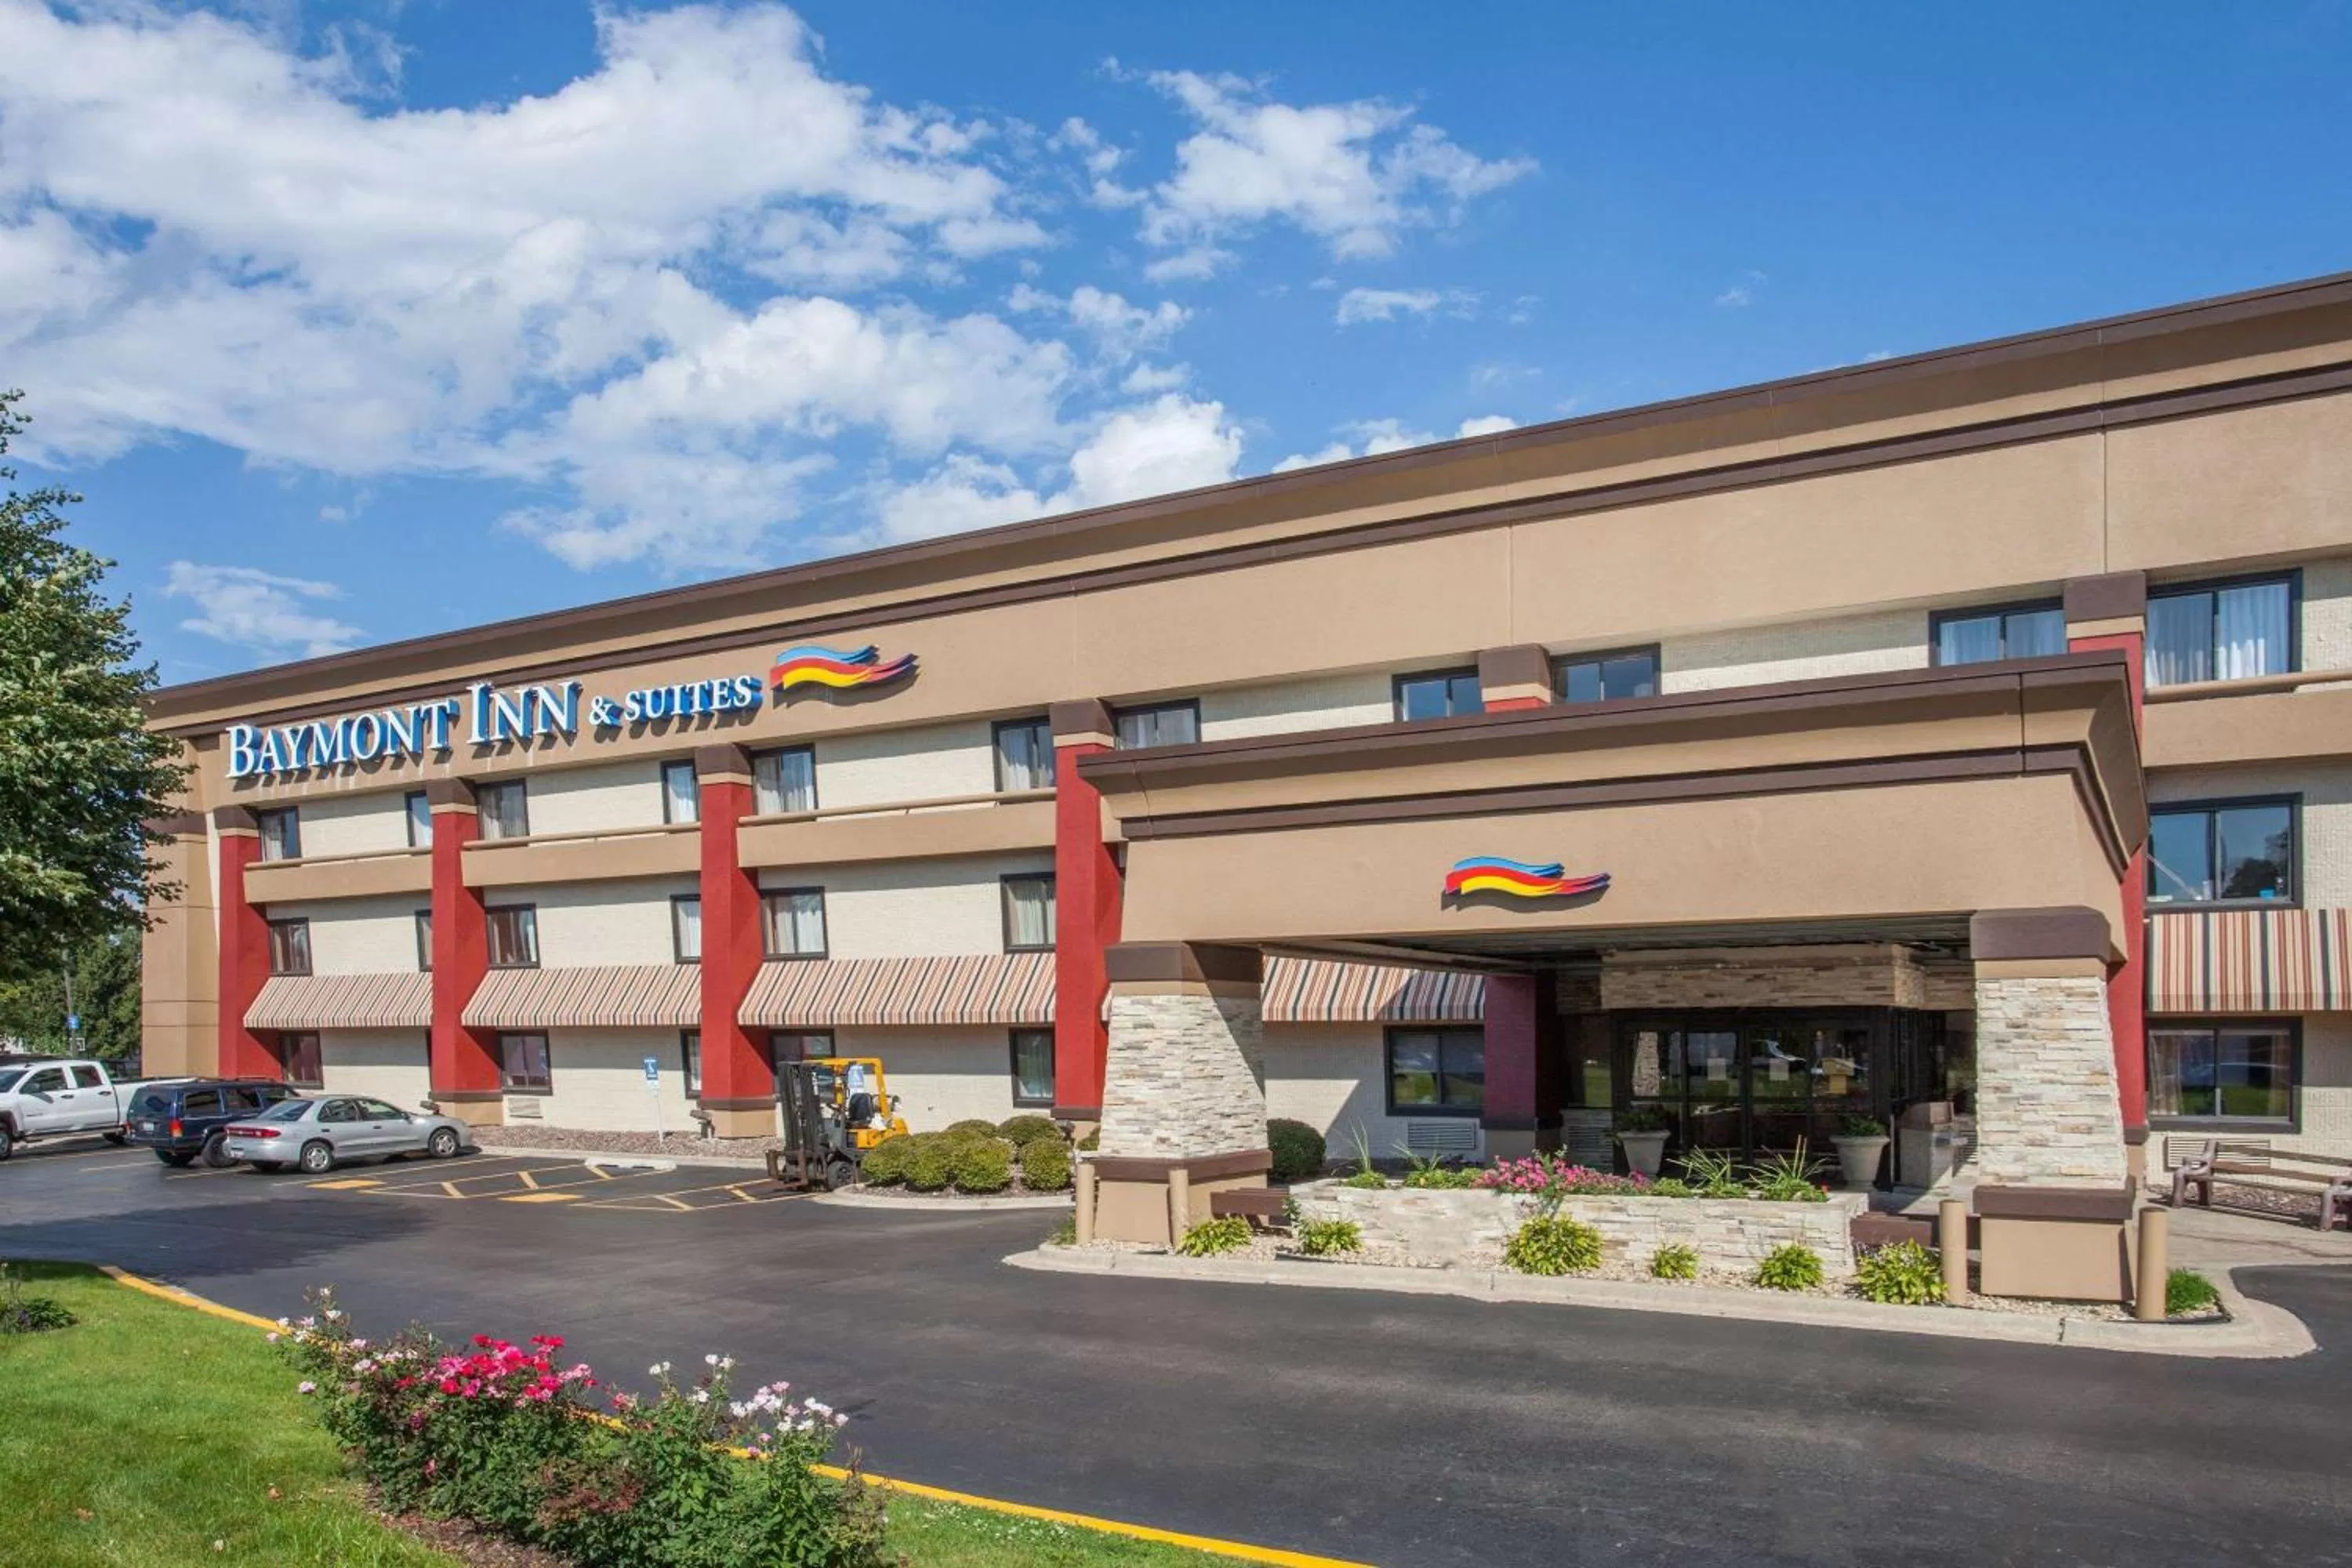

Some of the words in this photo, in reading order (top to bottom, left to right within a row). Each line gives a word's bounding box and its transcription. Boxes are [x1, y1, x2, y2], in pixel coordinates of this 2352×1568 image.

[226, 699, 456, 778] BAYMONT
[466, 681, 582, 744] INN
[589, 695, 619, 727] &
[624, 675, 758, 722] SUITES
